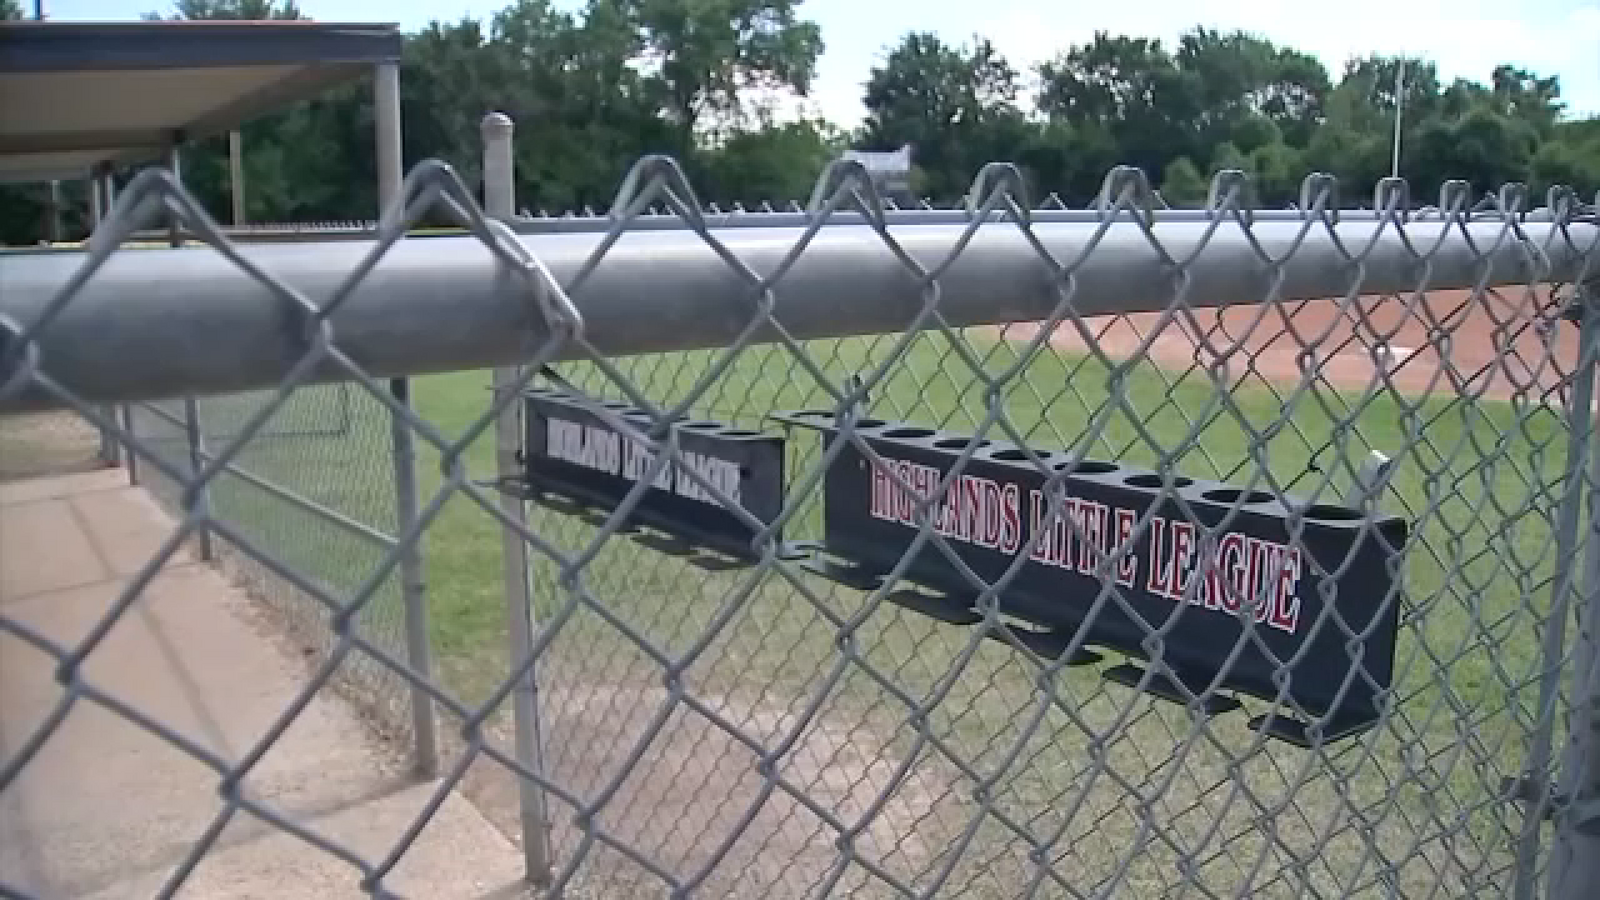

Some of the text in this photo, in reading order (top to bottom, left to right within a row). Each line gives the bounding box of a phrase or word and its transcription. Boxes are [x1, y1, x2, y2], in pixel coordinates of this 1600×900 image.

[870, 456, 1301, 634] HIGHLANDS LITTLE LEAGUE
